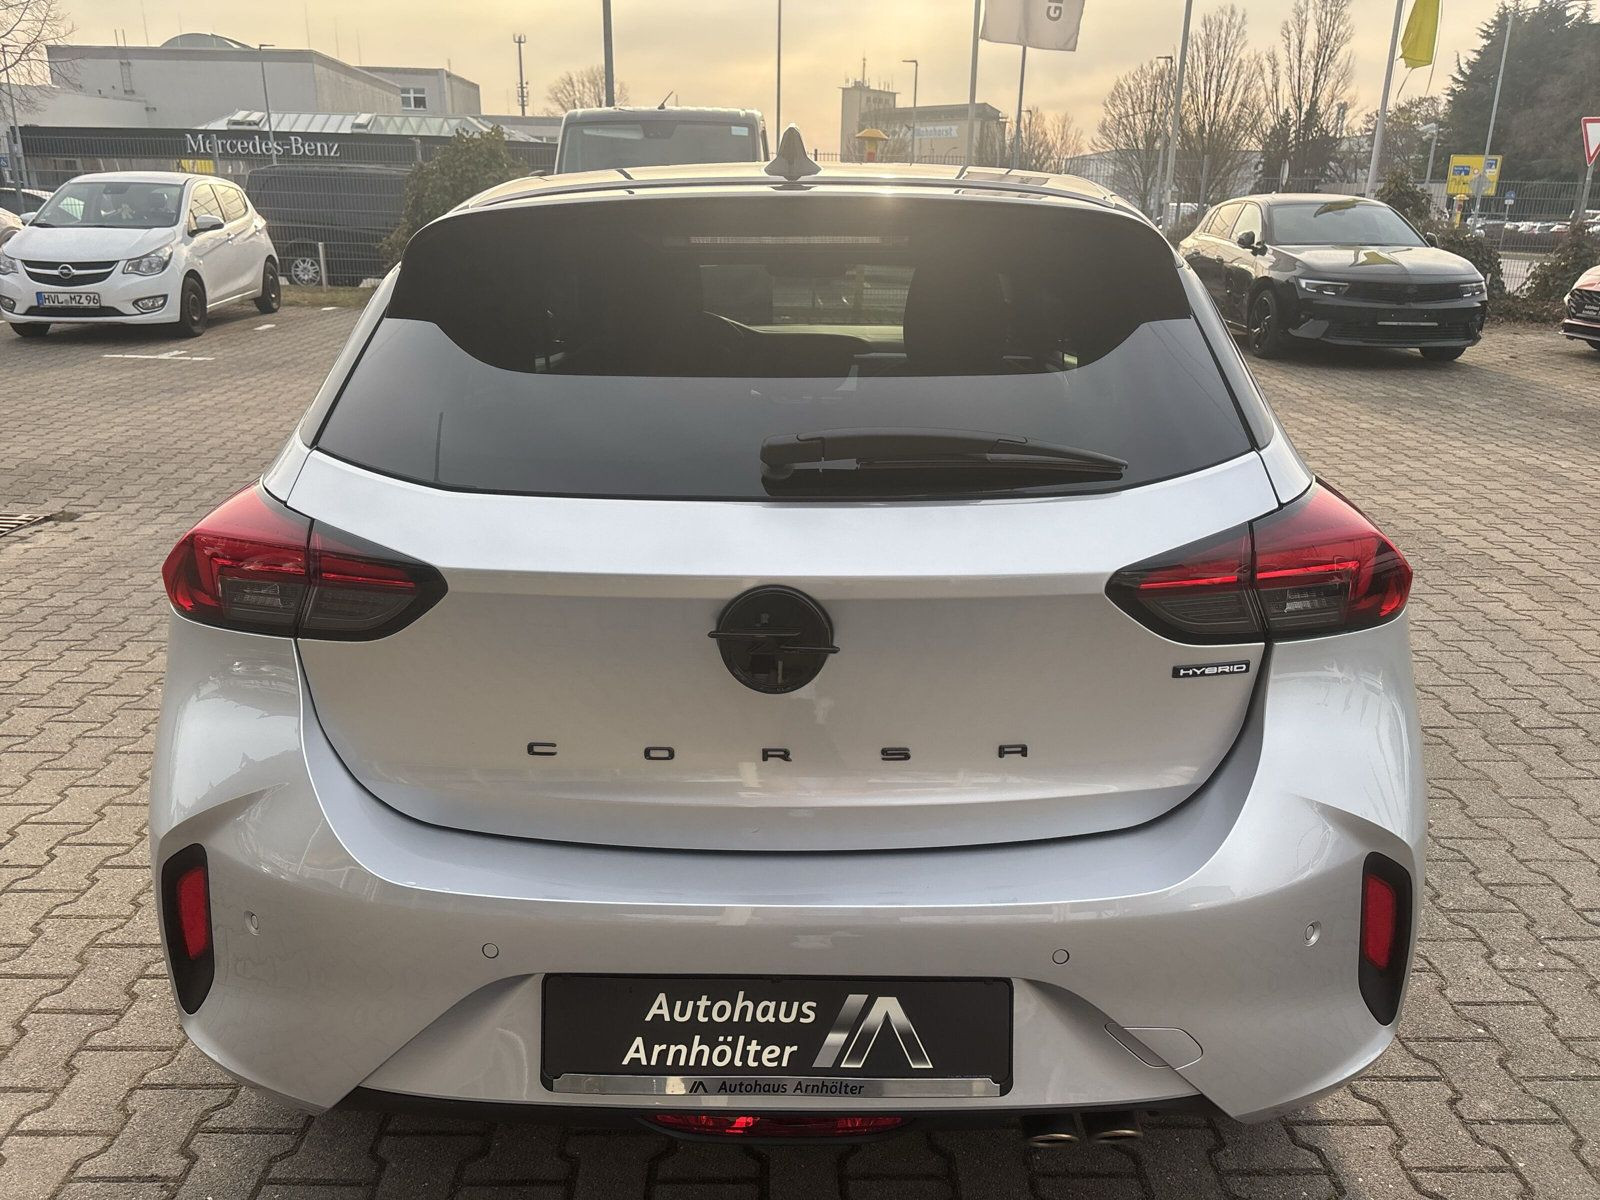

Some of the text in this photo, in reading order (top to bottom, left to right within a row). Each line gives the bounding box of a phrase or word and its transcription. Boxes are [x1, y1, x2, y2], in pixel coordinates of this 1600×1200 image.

[185, 133, 340, 157] Mercedes-Benz
[43, 294, 99, 305] HVL MZ 96
[1180, 664, 1247, 676] HYBRID
[527, 742, 1028, 762] CORSA
[644, 990, 817, 1024] Autohaus
[621, 1035, 798, 1067] Arnhölter
[717, 1080, 865, 1095] Autohaus Arnhölter
